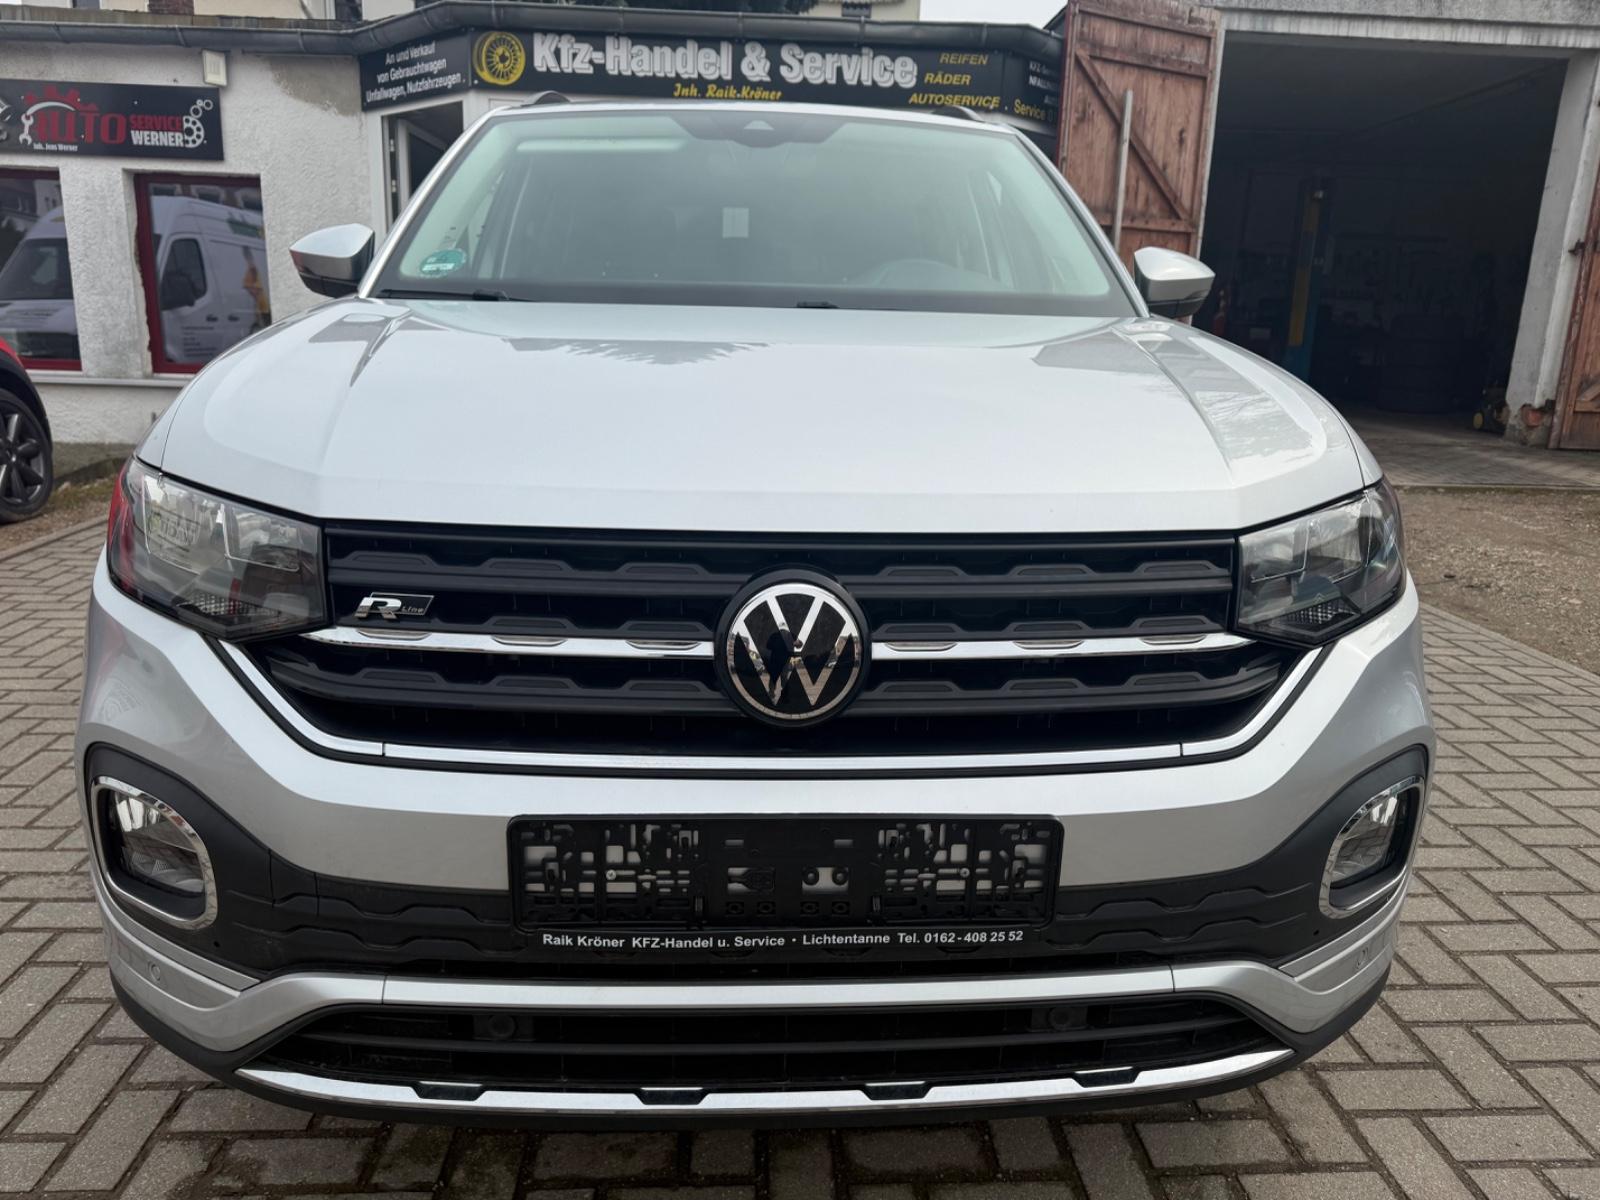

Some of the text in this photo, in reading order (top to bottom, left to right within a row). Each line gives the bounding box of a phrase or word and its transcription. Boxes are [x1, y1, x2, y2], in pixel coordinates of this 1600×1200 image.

[385, 40, 436, 65] An und Verkauf
[533, 32, 918, 88] Kfz-Handel & Service
[940, 53, 989, 65] REIFEN
[377, 58, 447, 84] von Gebrauchtwagen
[924, 72, 972, 86] RÄDER
[406, 72, 462, 94] Nutzfahrzeugen
[741, 86, 782, 100] Kröner
[909, 92, 1001, 108] AUTOSERVICE
[1014, 99, 1047, 120] Service
[130, 115, 184, 131] SERVICE
[130, 130, 185, 148] WERNER
[354, 596, 402, 619] R
[542, 933, 574, 946] Raik
[577, 935, 625, 948] Kröner
[632, 936, 714, 949] KFZ-Handel
[717, 938, 730, 948] u.
[734, 935, 786, 947] Service
[802, 933, 891, 945] Lichtentanne
[897, 932, 921, 944] Tel.
[1008, 930, 1024, 942] 52
